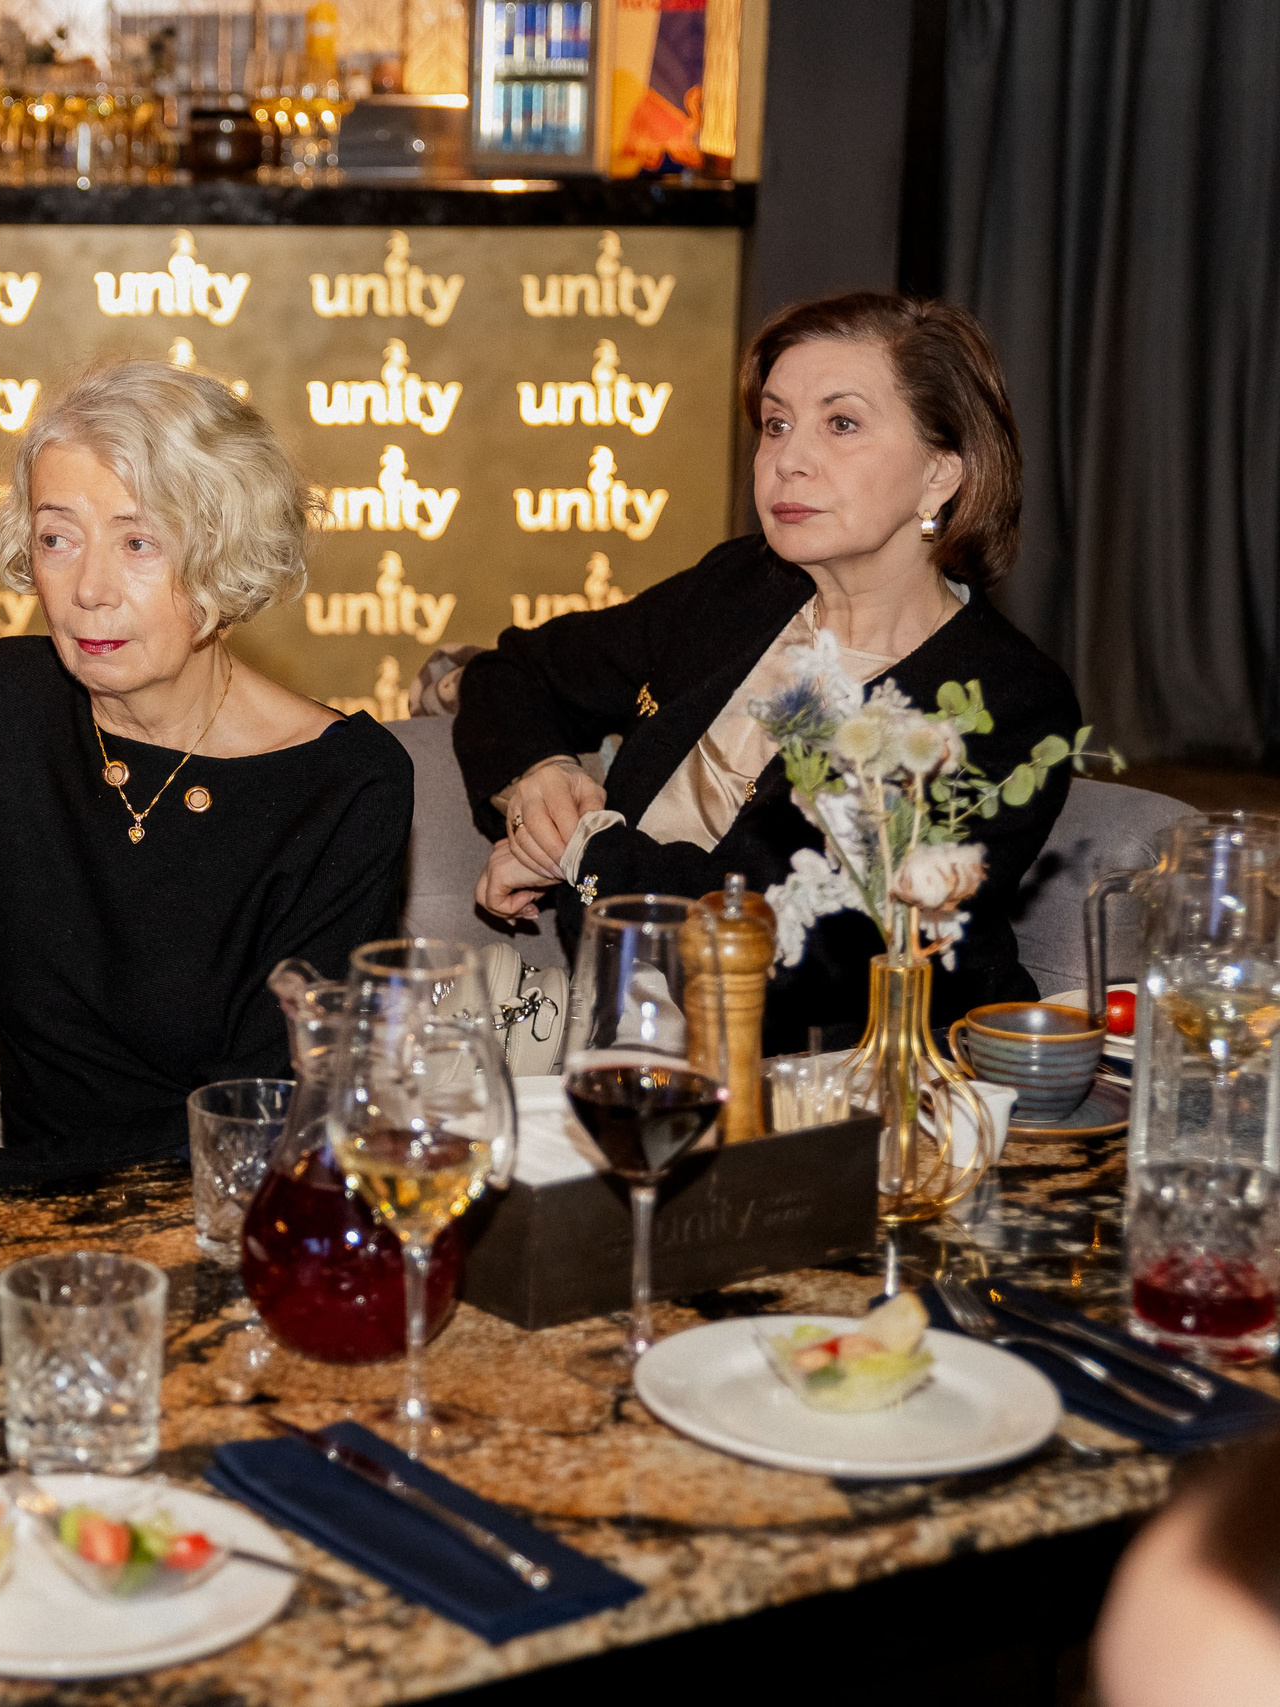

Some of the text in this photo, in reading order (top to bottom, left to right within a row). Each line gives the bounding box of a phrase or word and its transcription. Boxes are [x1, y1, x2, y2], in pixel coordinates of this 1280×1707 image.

[94, 229, 250, 325] unity
[309, 229, 464, 326] unity
[521, 229, 676, 326] unity
[307, 338, 462, 435] unity
[517, 339, 672, 435] unity
[514, 445, 669, 541] unity
[306, 551, 457, 643] unity
